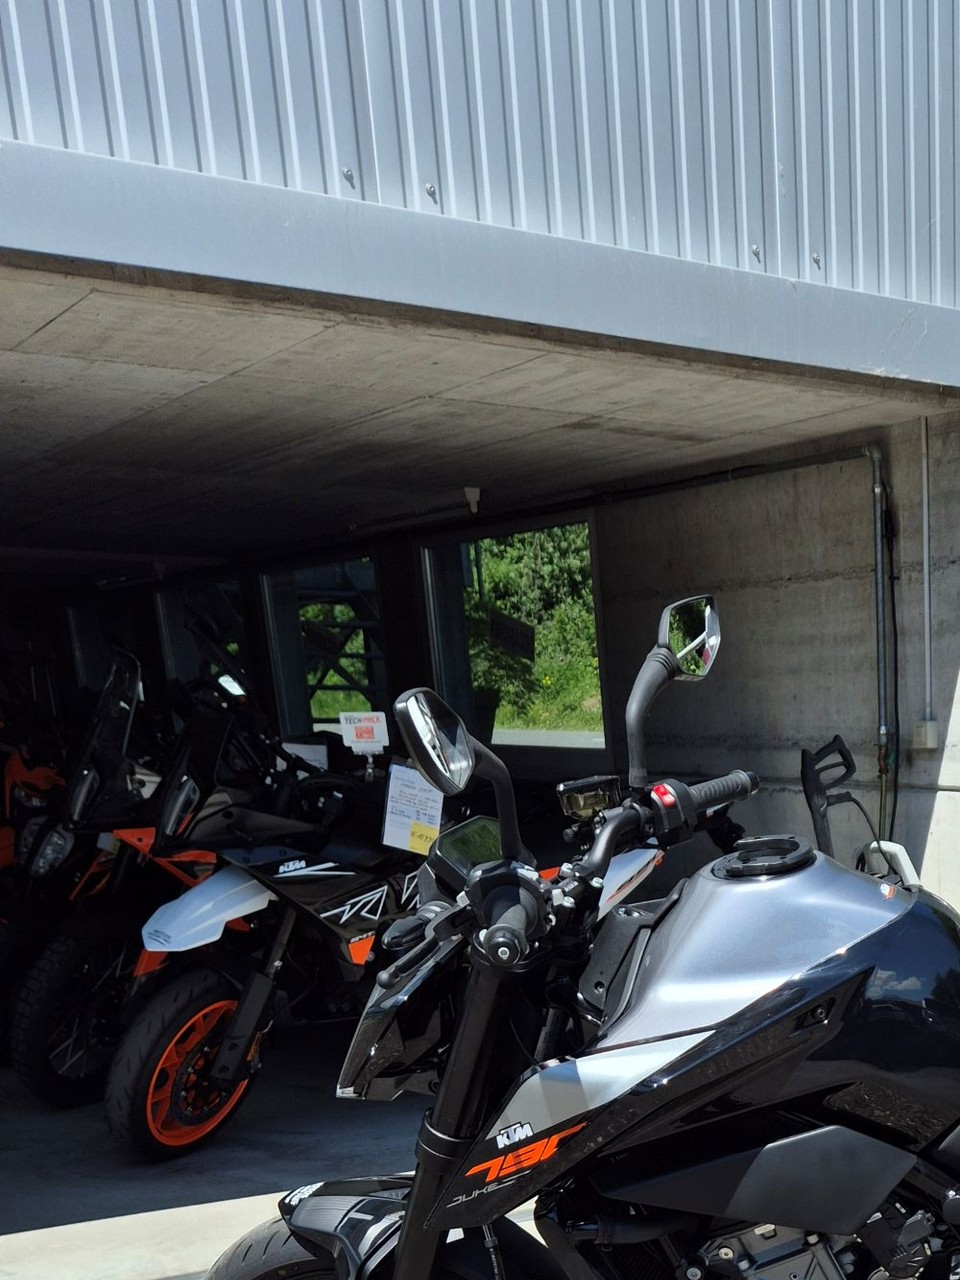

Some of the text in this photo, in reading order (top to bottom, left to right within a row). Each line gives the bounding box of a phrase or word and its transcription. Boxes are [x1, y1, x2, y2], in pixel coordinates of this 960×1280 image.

[278, 860, 307, 874] KTM
[496, 1122, 534, 1149] KTM
[446, 1169, 532, 1208] DUKE
